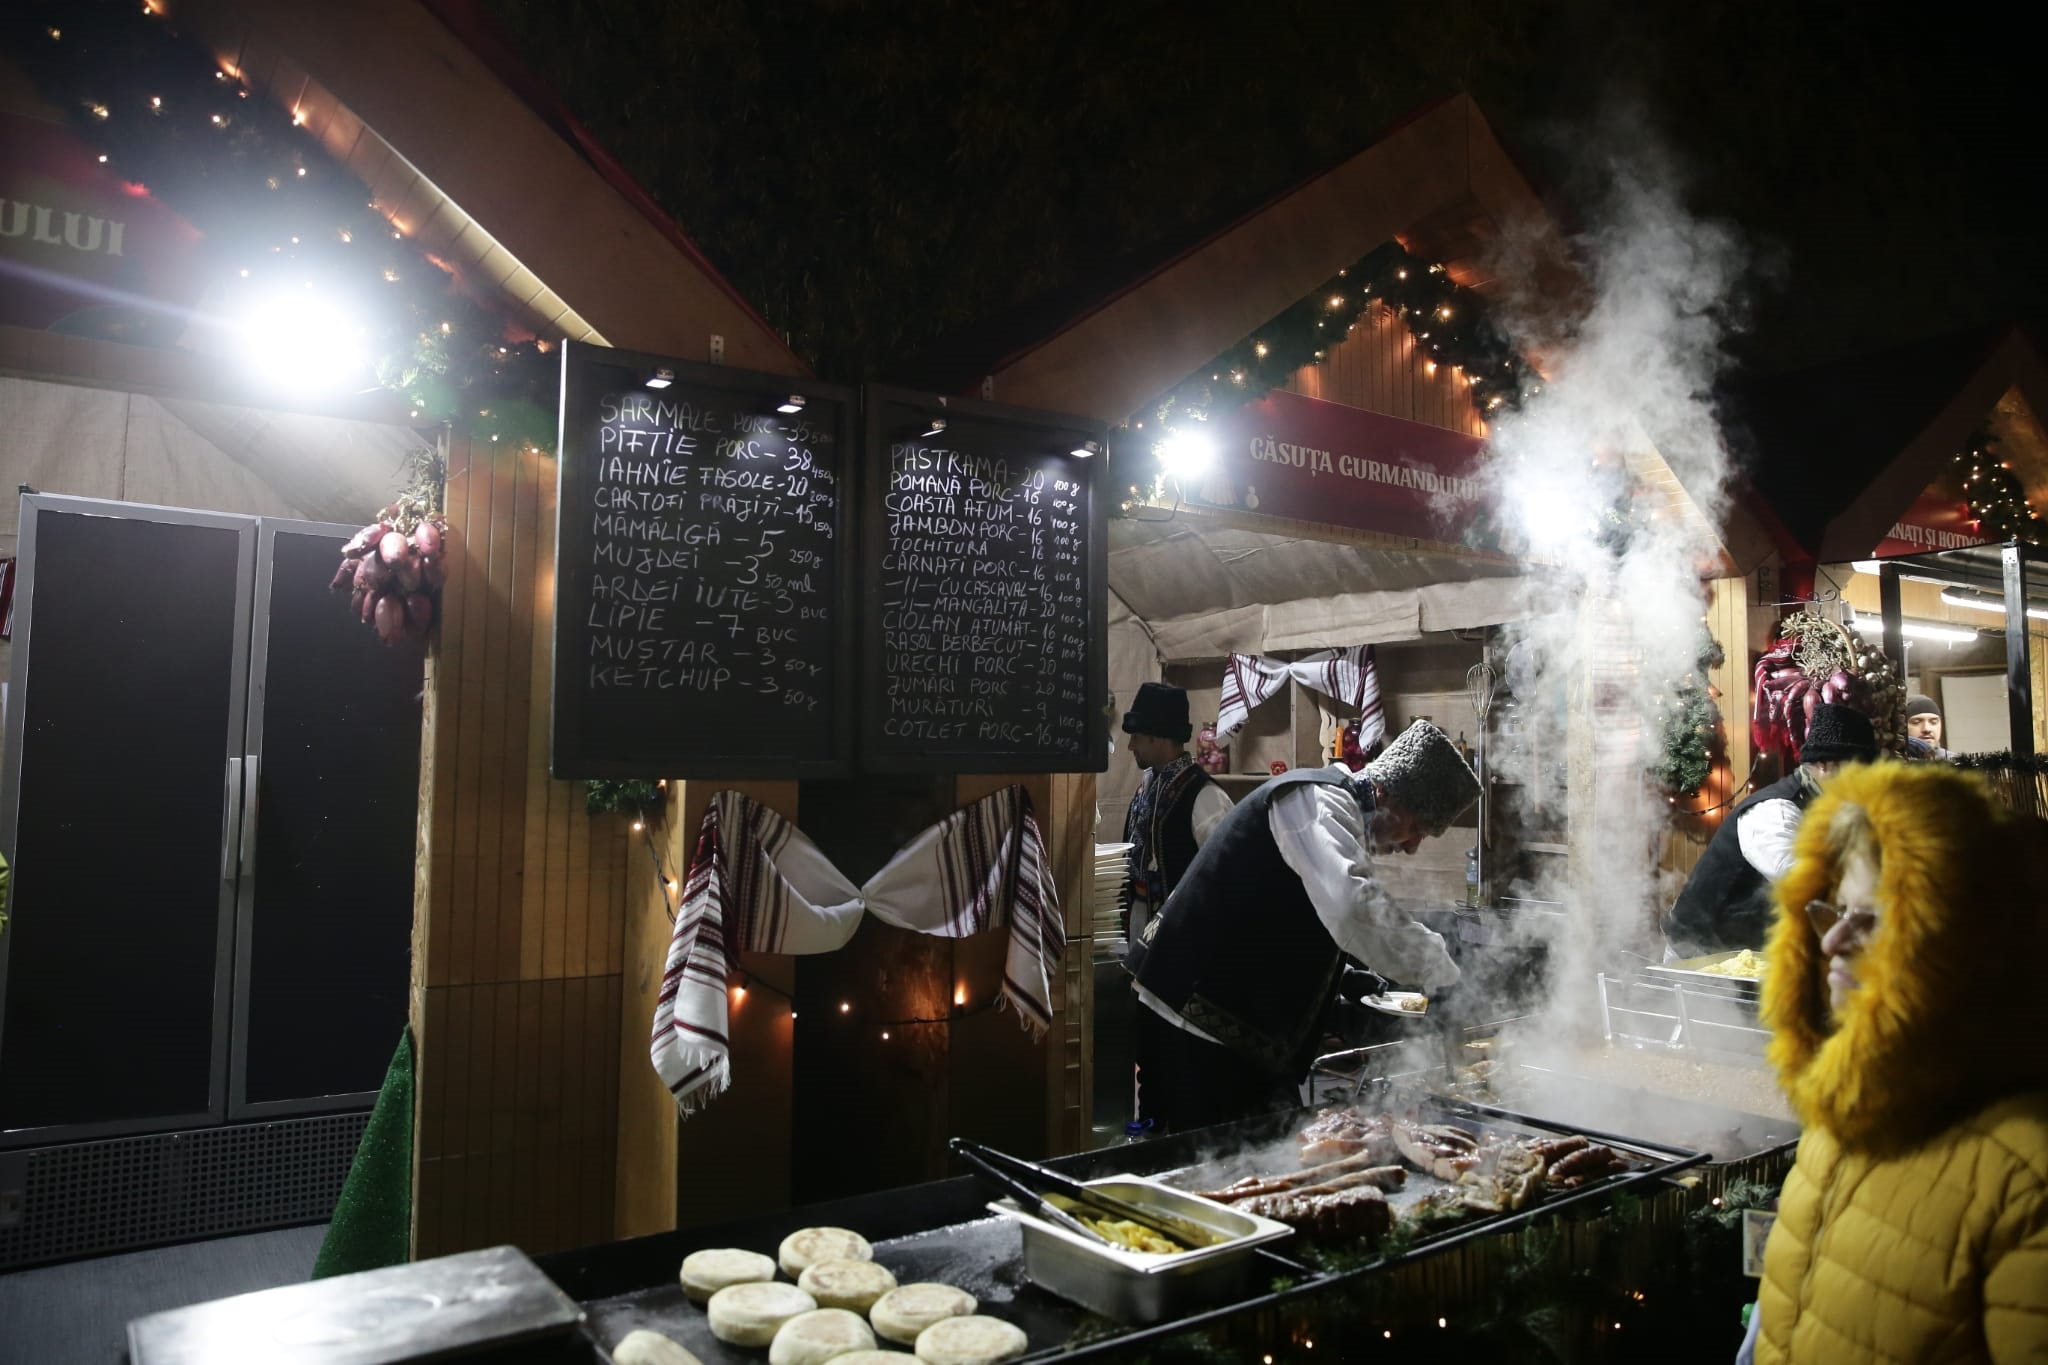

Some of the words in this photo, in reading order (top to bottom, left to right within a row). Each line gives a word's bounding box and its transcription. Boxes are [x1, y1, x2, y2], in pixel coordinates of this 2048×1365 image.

[600, 394, 722, 432] SARMALE
[734, 412, 775, 433] PORC
[715, 437, 760, 460] PORC
[784, 447, 813, 471] 38
[699, 467, 774, 491] FASOLE
[1250, 435, 1334, 478] CĂSUȚA
[1338, 455, 1480, 500] GURMANDULUI
[969, 479, 1013, 501] PORC
[888, 514, 975, 536] JAMBON
[979, 521, 1019, 542] PORC
[973, 559, 1017, 577] PORC
[592, 574, 684, 603] ARDEI
[939, 578, 960, 595] CU
[588, 600, 666, 632] LIPIE
[718, 614, 745, 638] 7
[756, 627, 799, 644] BUC
[883, 611, 960, 634] CIOLAN
[885, 632, 936, 651] RASOL
[886, 653, 960, 675] URECHI
[974, 655, 1018, 674] PORC
[590, 664, 731, 691] KETCHUP
[970, 679, 1009, 695] PORC
[884, 719, 968, 738] COTLET
[979, 722, 1023, 742] PORC
